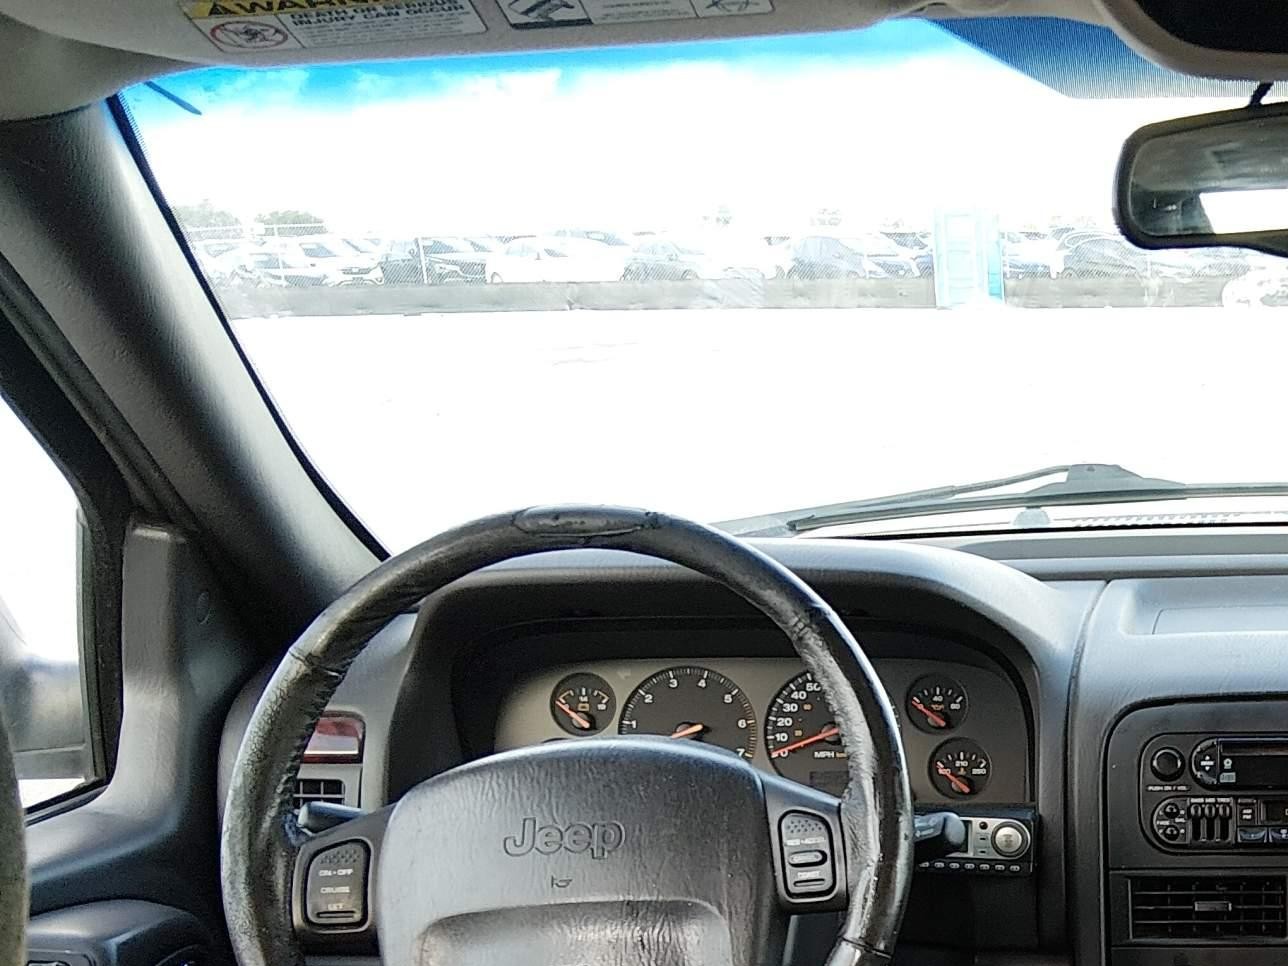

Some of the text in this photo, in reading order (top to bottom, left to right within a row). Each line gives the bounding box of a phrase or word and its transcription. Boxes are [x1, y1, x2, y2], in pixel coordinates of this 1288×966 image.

[291, 9, 347, 19] DEATH
[292, 15, 356, 26] INJURY
[363, 10, 401, 19] CAN
[669, 679, 678, 688] 3
[698, 679, 707, 688] 4
[644, 694, 653, 704] 2
[724, 694, 732, 704] 5
[791, 691, 807, 700] 40
[783, 703, 798, 712] 30
[737, 719, 746, 728] 6
[777, 718, 792, 726] 20
[775, 733, 788, 742] 10
[736, 748, 745, 757] 7
[503, 816, 626, 861] Jeep
